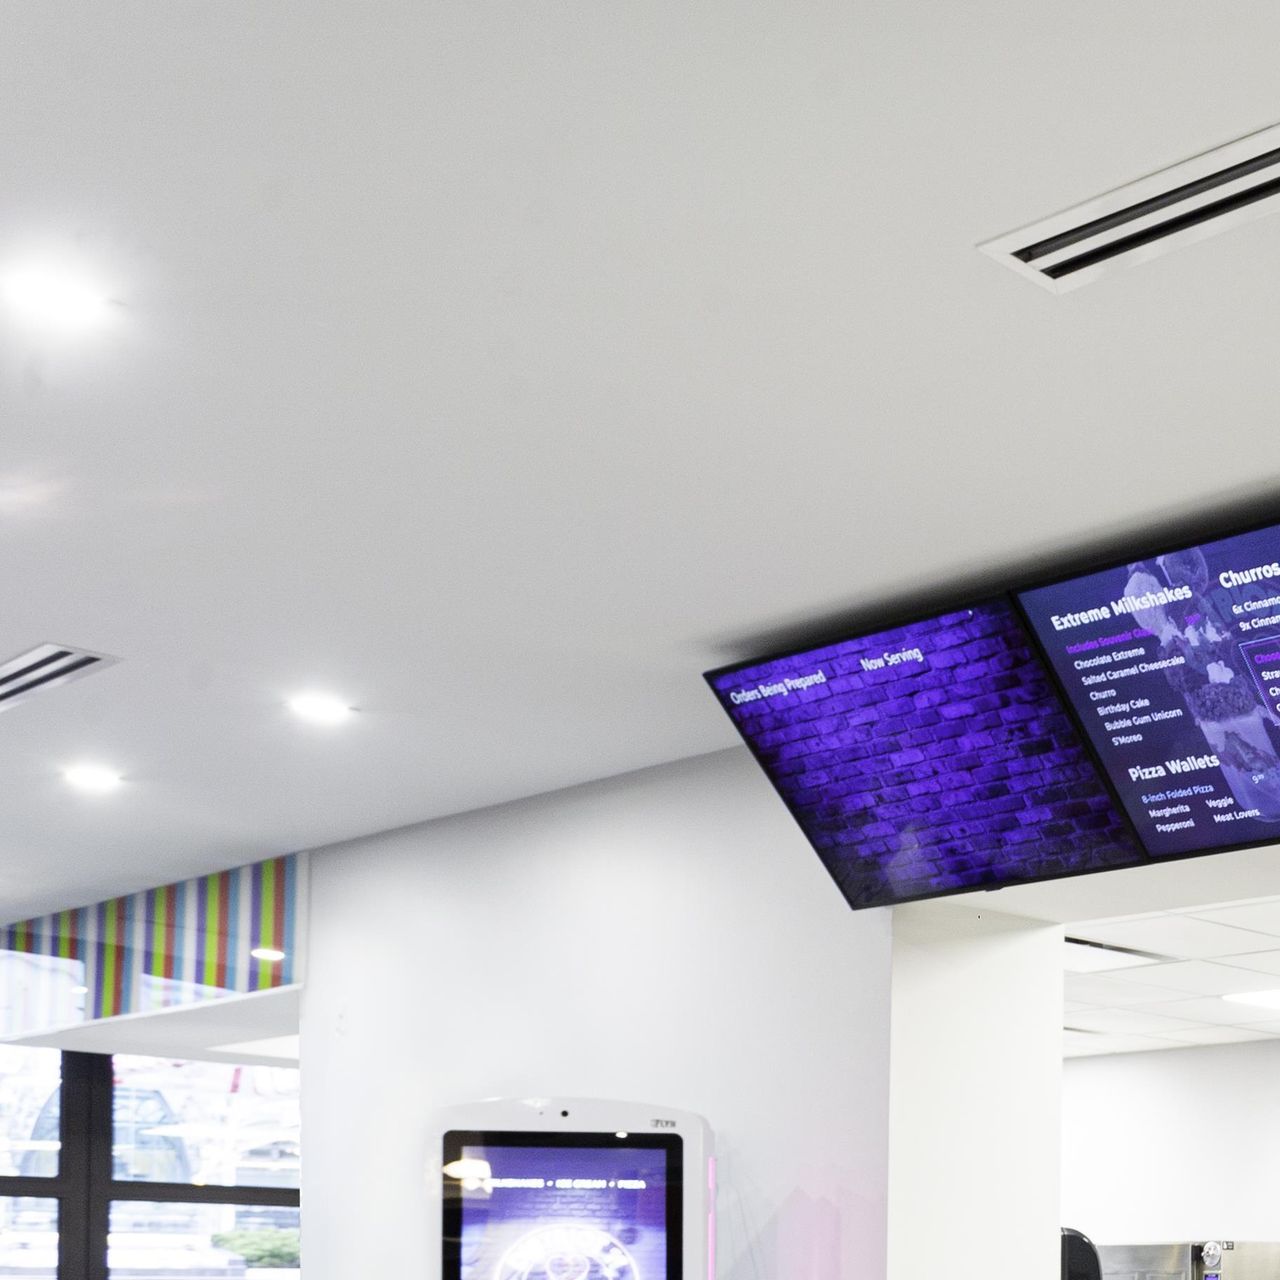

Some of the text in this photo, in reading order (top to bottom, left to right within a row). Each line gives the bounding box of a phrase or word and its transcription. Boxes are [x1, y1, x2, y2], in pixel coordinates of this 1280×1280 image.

[1051, 585, 1193, 631] Extreme Milkshakes
[860, 648, 924, 671] Now Serving
[1074, 647, 1145, 670] Chocolate Extreme
[1089, 688, 1117, 701] Churro
[1097, 698, 1150, 716] Birthday Cake
[1132, 715, 1152, 726] Gum
[1151, 708, 1183, 722] Unicorn
[1128, 754, 1220, 782] Pizza Wallets
[1193, 783, 1215, 795] Pizza
[1205, 795, 1234, 809] Veggie
[1213, 808, 1261, 824] Meat Lovers
